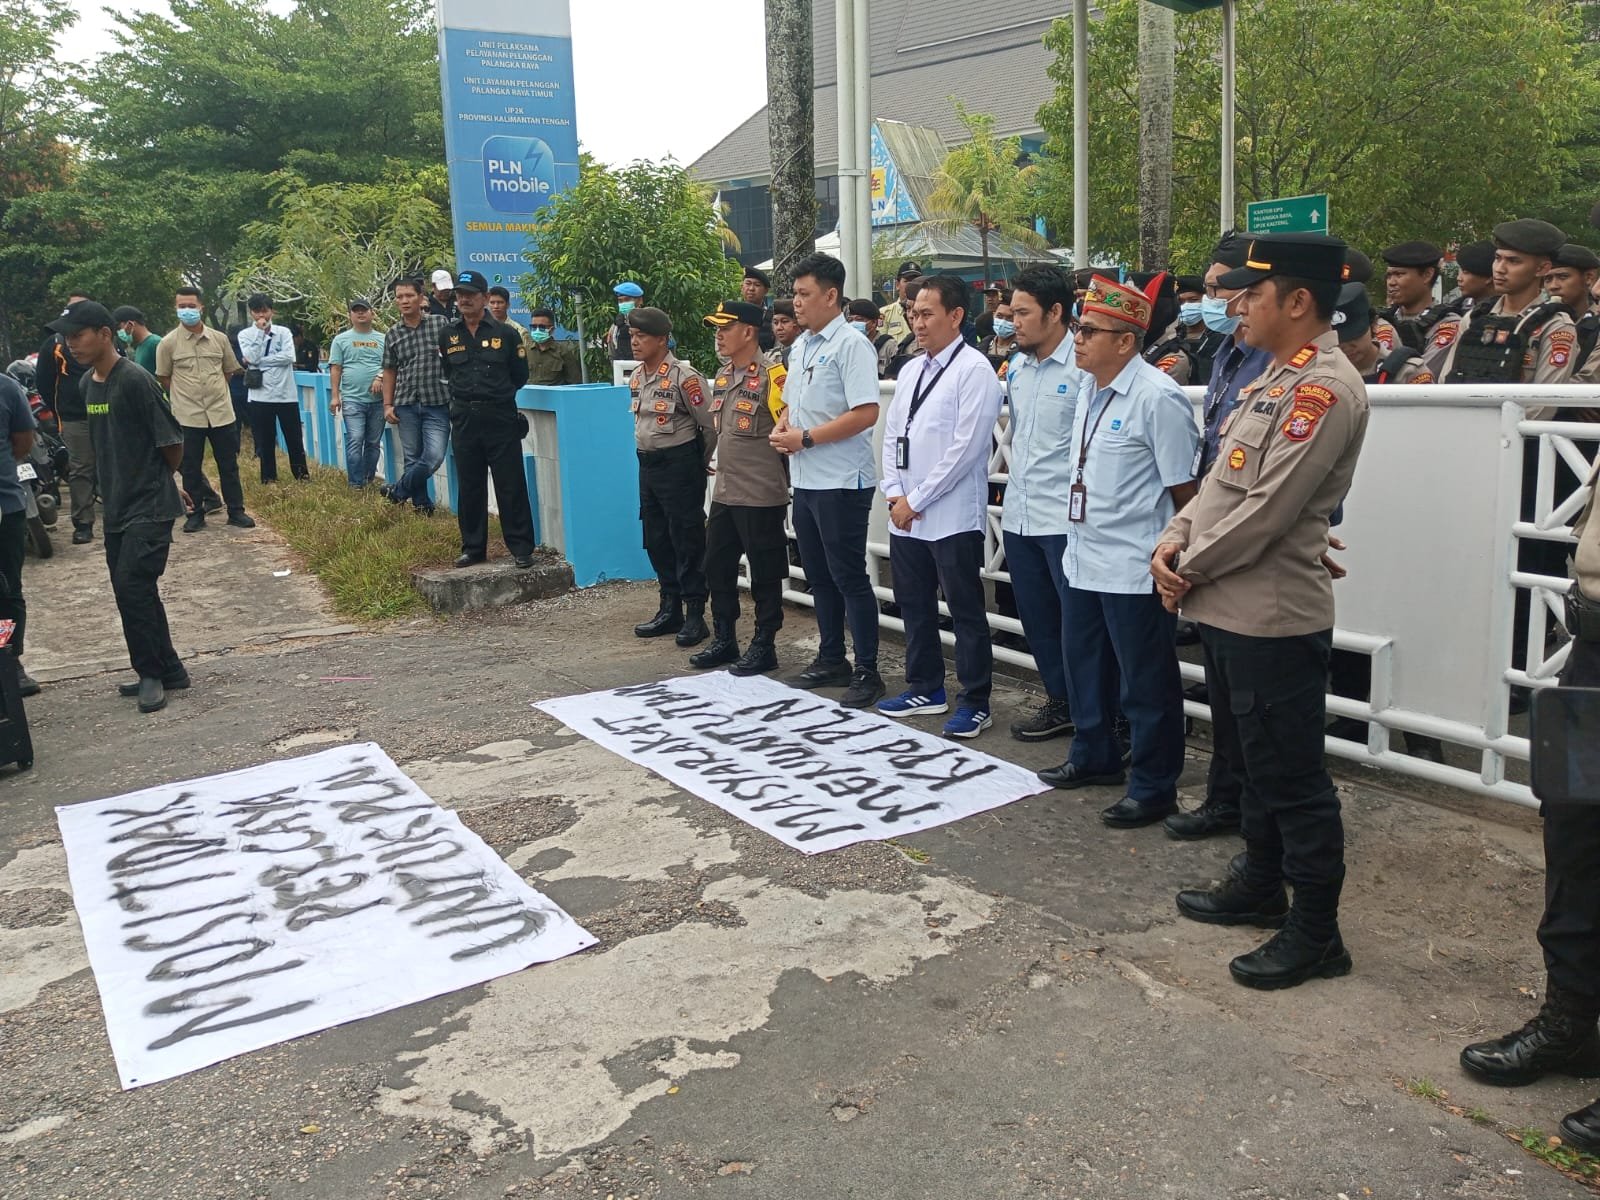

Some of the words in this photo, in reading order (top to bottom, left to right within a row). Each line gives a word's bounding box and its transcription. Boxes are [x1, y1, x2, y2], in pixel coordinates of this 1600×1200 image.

[478, 41, 495, 49] UNIT
[497, 42, 539, 51] PELAKSANA
[466, 49, 509, 58] PELAYANAN
[509, 52, 553, 61] PELANGGAN
[481, 59, 520, 68] PALANGKA
[521, 62, 539, 70] RAYA
[463, 76, 480, 84] UNIT
[482, 78, 515, 87] LAYANAN
[516, 80, 560, 89] PELANGGAN
[471, 86, 510, 95] PALANGKA
[531, 90, 554, 98] TIMUR
[458, 113, 493, 122] PROVINSI
[494, 115, 540, 124] KALIMANTAN
[541, 117, 570, 126] TENGAH
[488, 159, 522, 175] PLN
[490, 176, 549, 194] mobile
[465, 221, 503, 232] SEMUA
[469, 252, 518, 263] CONTACT
[653, 390, 673, 399] POLRI
[738, 389, 760, 401] POLRI
[733, 697, 890, 745] PLN
[655, 701, 944, 824] MENUNTUT
[592, 715, 865, 841] MASYARAKAT
[97, 791, 236, 912] TIDAK
[215, 786, 394, 932] PERCAYA
[361, 813, 549, 962] UNTUK
[121, 893, 318, 1051] MOSI
